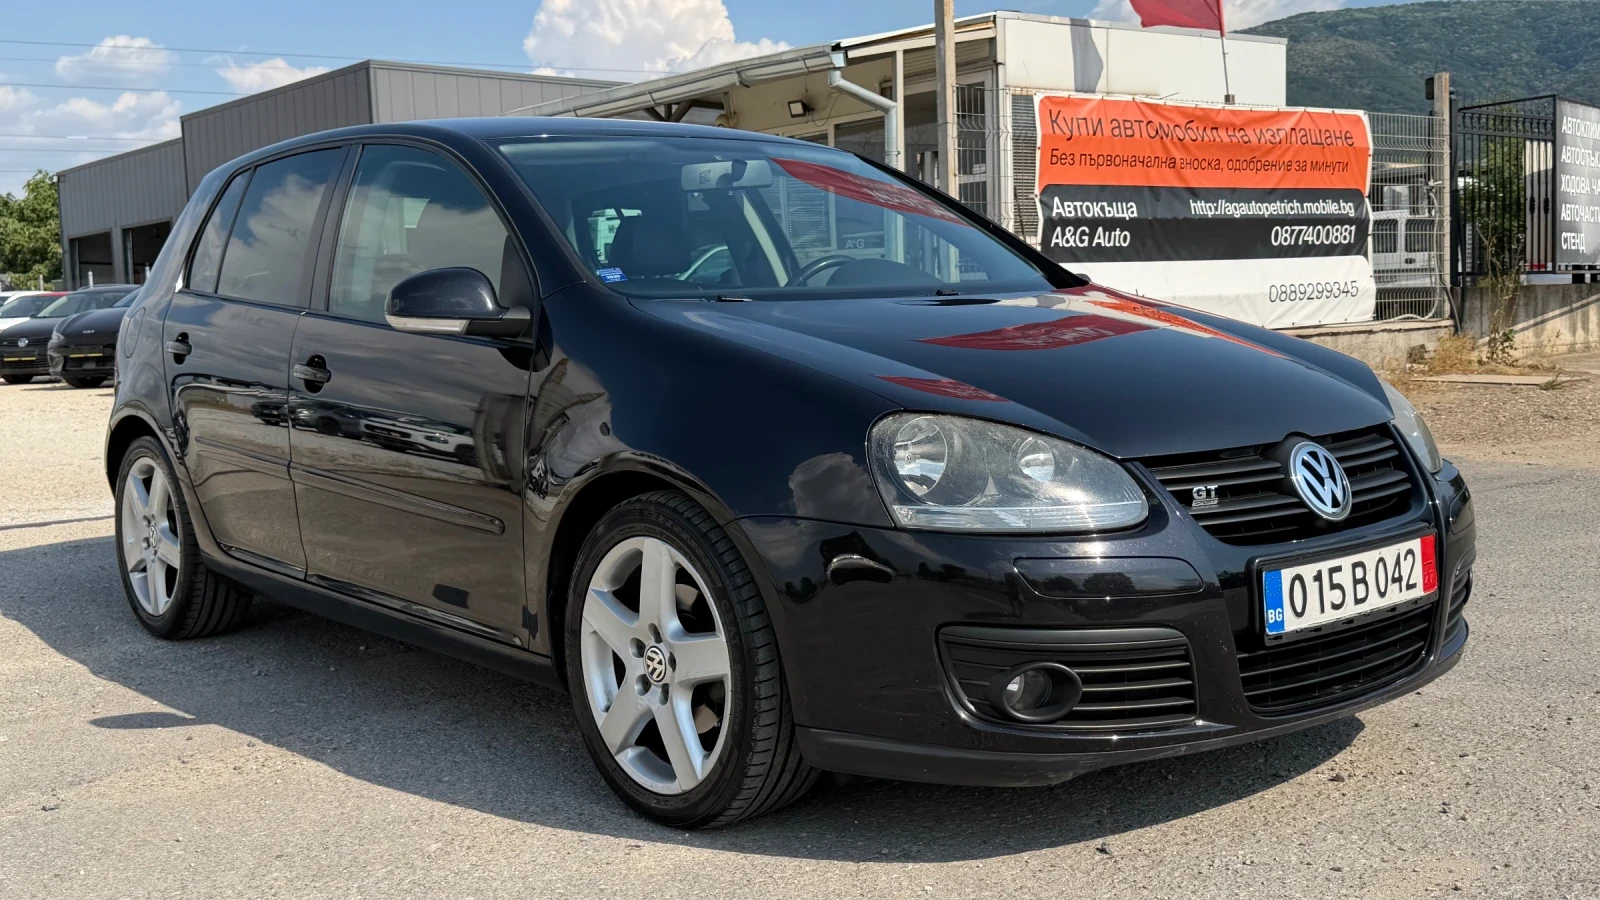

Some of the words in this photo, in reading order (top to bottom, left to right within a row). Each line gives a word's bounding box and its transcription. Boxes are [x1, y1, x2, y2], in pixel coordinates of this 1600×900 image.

[1049, 109, 1104, 141] Купи
[1110, 118, 1223, 143] автомобил
[1226, 127, 1252, 144] на
[1253, 127, 1355, 149] изплащане
[1050, 148, 1076, 166] Без
[1079, 153, 1177, 170] първоначална
[1180, 157, 1223, 173] вноска,
[1227, 156, 1293, 173] одобрение
[1294, 161, 1307, 172] за
[1310, 160, 1349, 175] минути
[1561, 174, 1591, 196] ХОДОВА
[1052, 196, 1138, 220] Автокъща
[1189, 199, 1355, 218] http://agautopetrich.mobile.bg
[1051, 226, 1090, 248] A&G
[1092, 226, 1131, 247] Auto
[1270, 225, 1356, 246] 0877400881
[1561, 232, 1586, 253] СТЕНД
[1269, 280, 1359, 303] 0889299345
[1192, 485, 1219, 499] GT
[721, 601, 741, 646] CEAT
[1268, 607, 1283, 623] BG
